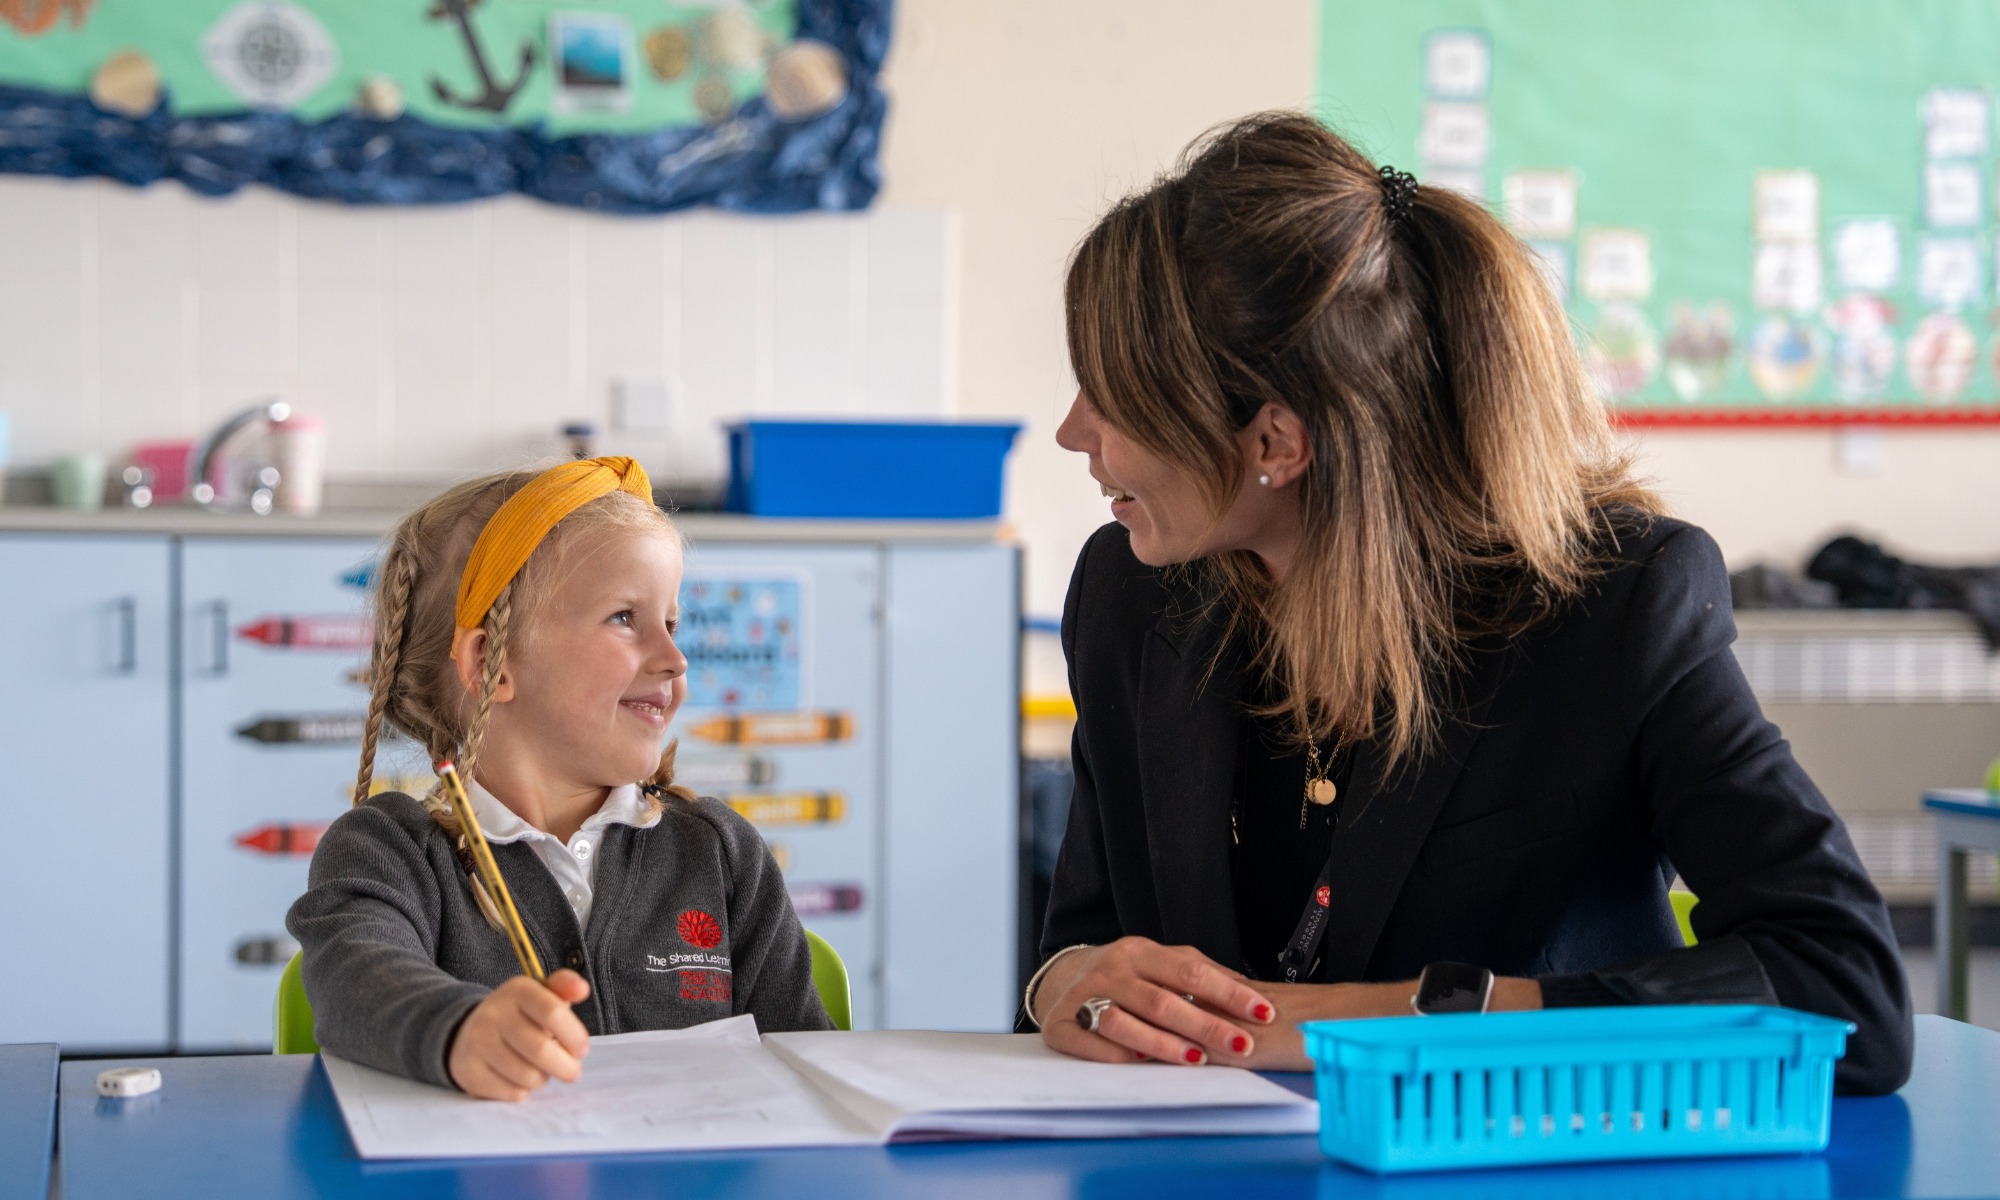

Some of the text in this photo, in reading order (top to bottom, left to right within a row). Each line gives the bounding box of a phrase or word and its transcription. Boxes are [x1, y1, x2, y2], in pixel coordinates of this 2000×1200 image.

[1302, 907, 1324, 954] ADVANTAG
[647, 955, 667, 966] The
[669, 952, 704, 964] Shared
[679, 971, 708, 985] THE
